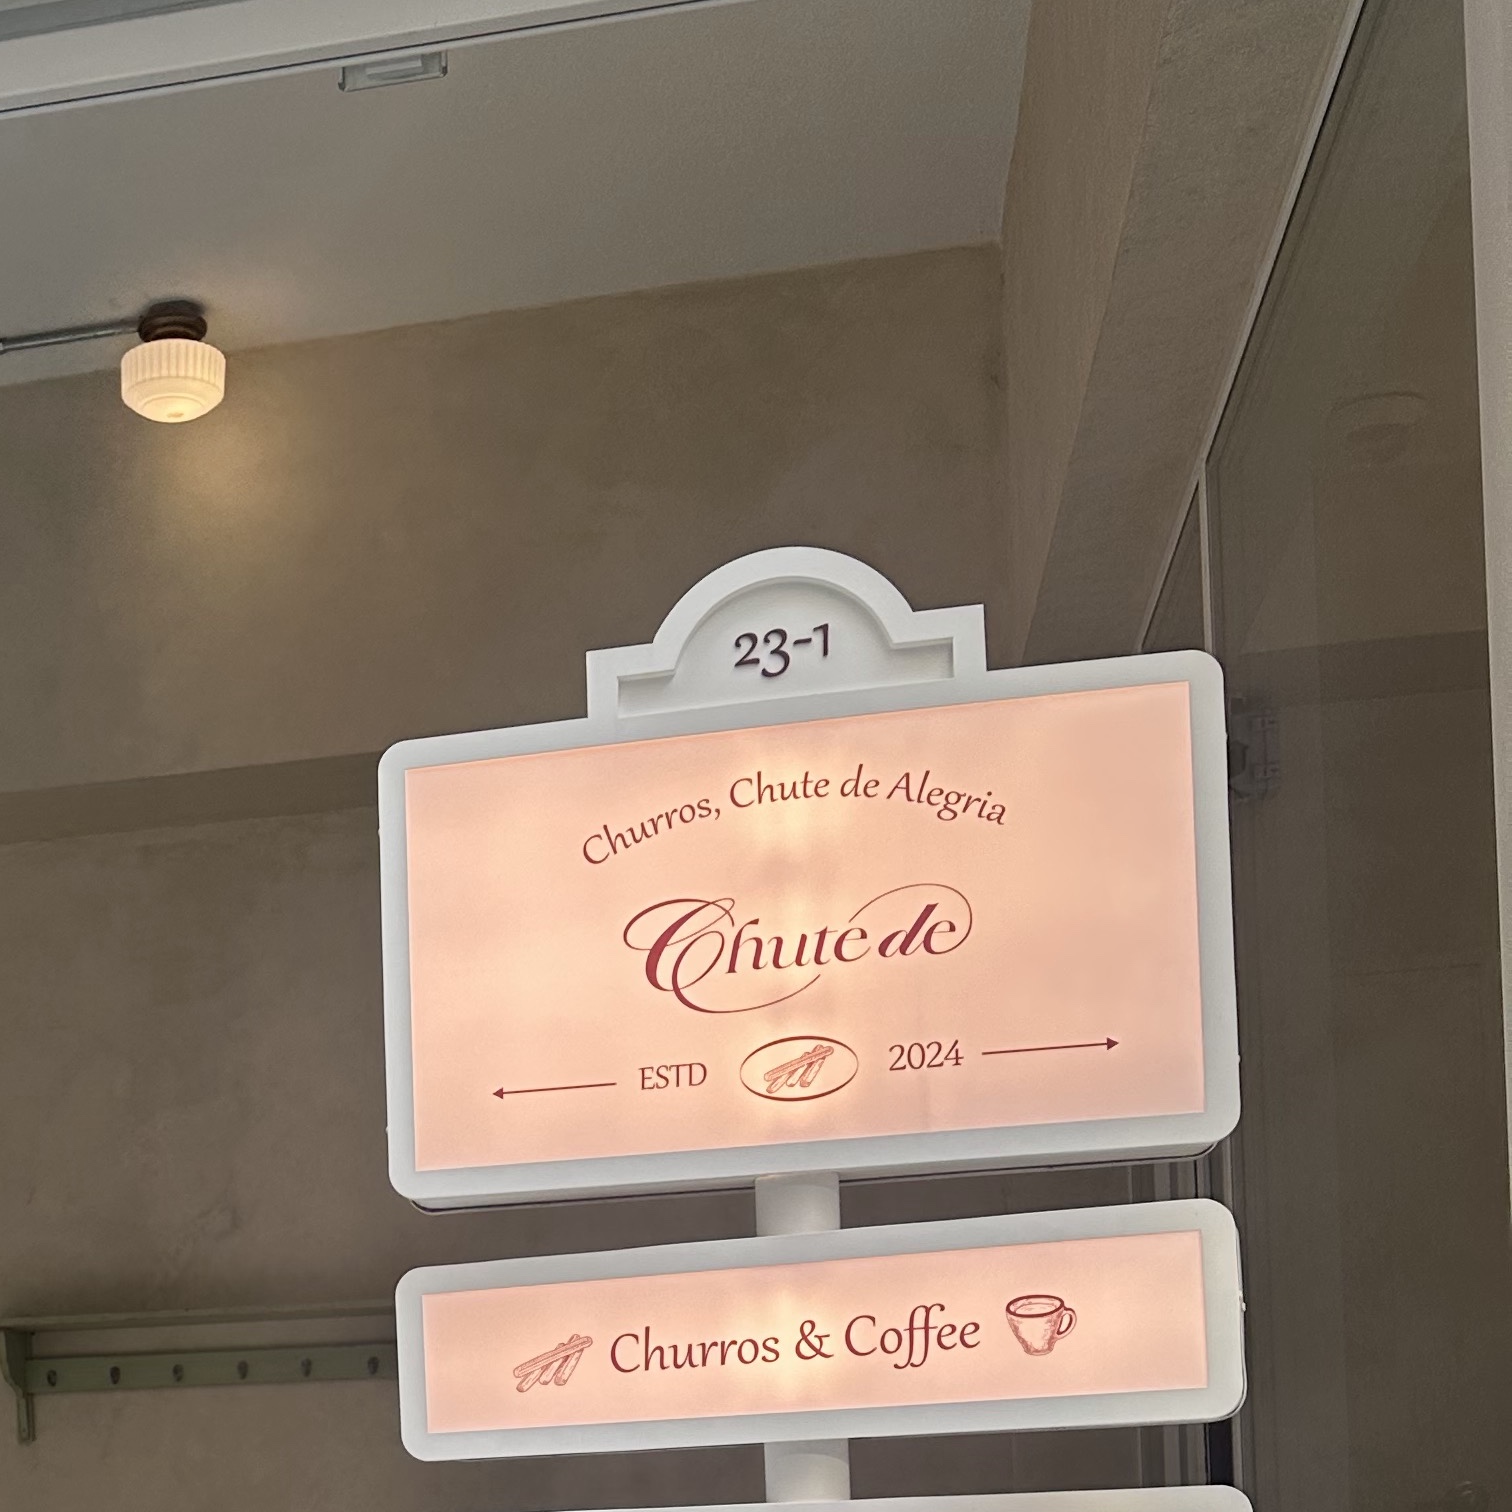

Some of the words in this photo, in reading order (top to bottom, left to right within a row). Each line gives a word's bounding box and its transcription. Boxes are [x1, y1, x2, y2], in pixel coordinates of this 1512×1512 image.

[733, 622, 830, 681] 23-1
[582, 798, 721, 865] Churros,
[729, 770, 830, 809] Chute
[839, 763, 880, 799] de
[885, 769, 1006, 826] Alegria
[622, 897, 872, 1015] Chute
[849, 882, 973, 959] de
[638, 1062, 708, 1091] ESTD
[888, 1039, 965, 1072] 2024
[610, 1325, 780, 1374] Churros
[794, 1319, 835, 1361] &
[844, 1302, 981, 1370] Coffee
